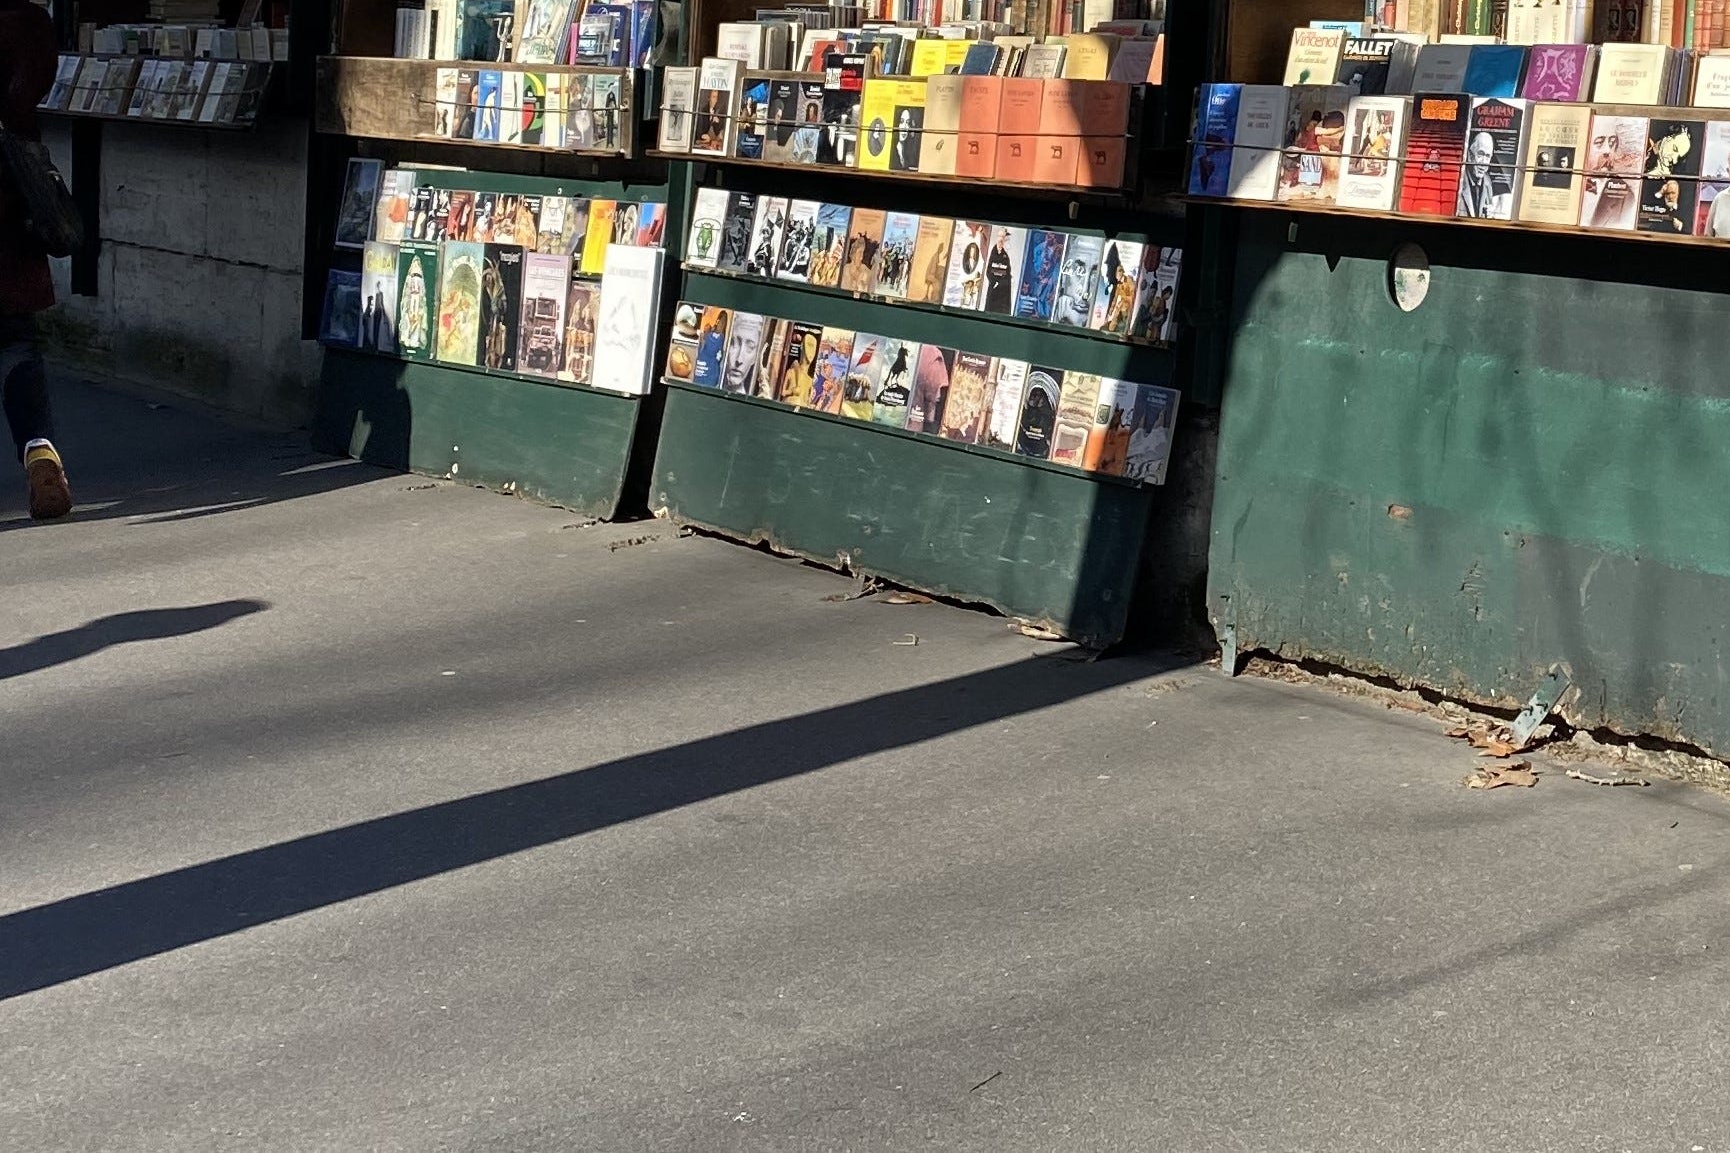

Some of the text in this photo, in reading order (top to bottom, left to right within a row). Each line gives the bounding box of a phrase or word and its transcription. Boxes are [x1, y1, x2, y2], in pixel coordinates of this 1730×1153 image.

[1295, 31, 1340, 48] Vincenot
[1344, 40, 1393, 56] FALLET
[703, 77, 729, 88] HAYDN
[1477, 104, 1515, 118] GRAHAM
[1477, 116, 1511, 128] GREENE
[1300, 155, 1322, 173] SAND
